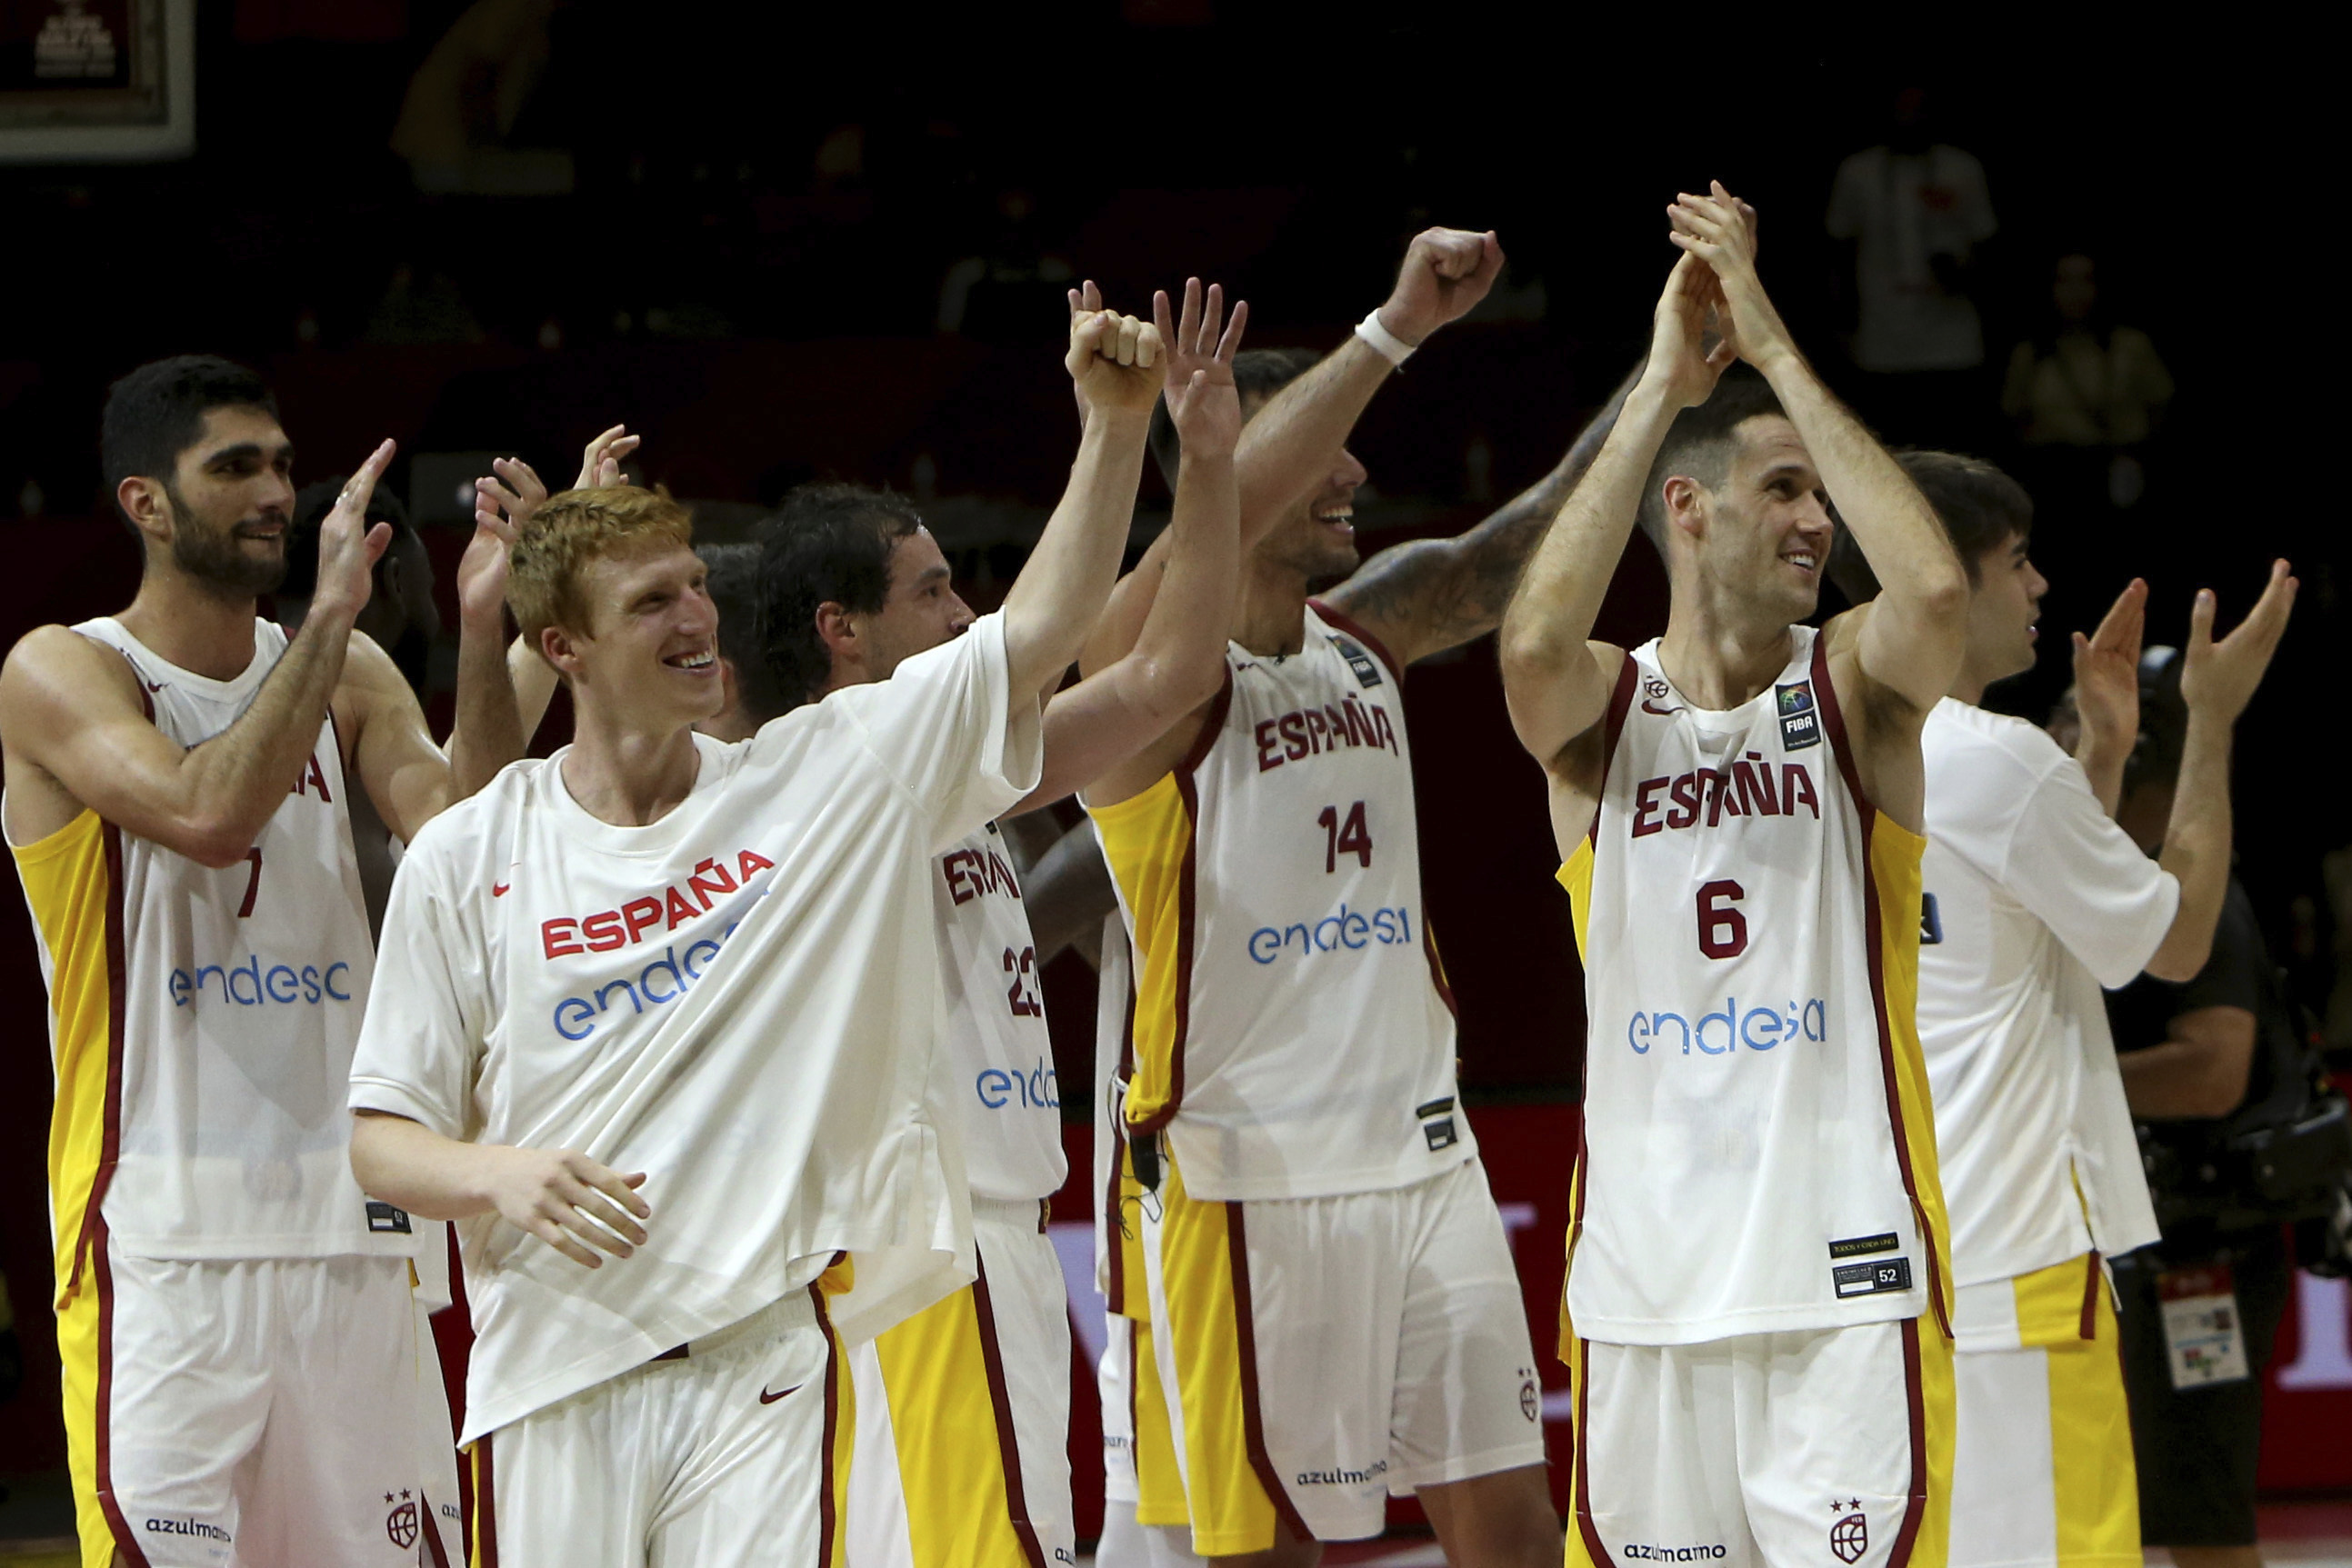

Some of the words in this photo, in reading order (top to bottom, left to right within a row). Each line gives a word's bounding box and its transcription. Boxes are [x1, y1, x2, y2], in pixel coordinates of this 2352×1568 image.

[1255, 692, 1399, 773] ESPAÑA
[1786, 715, 1813, 734] FIBA
[1632, 751, 1820, 838] ESPAÑA
[1317, 801, 1373, 874] 14
[541, 849, 775, 960] ESPAÑA
[1696, 879, 1747, 960] 6
[554, 922, 739, 1041] ende
[1003, 946, 1042, 1018] 23
[1628, 997, 1826, 1054] endesa
[1878, 1268, 1897, 1283] 52
